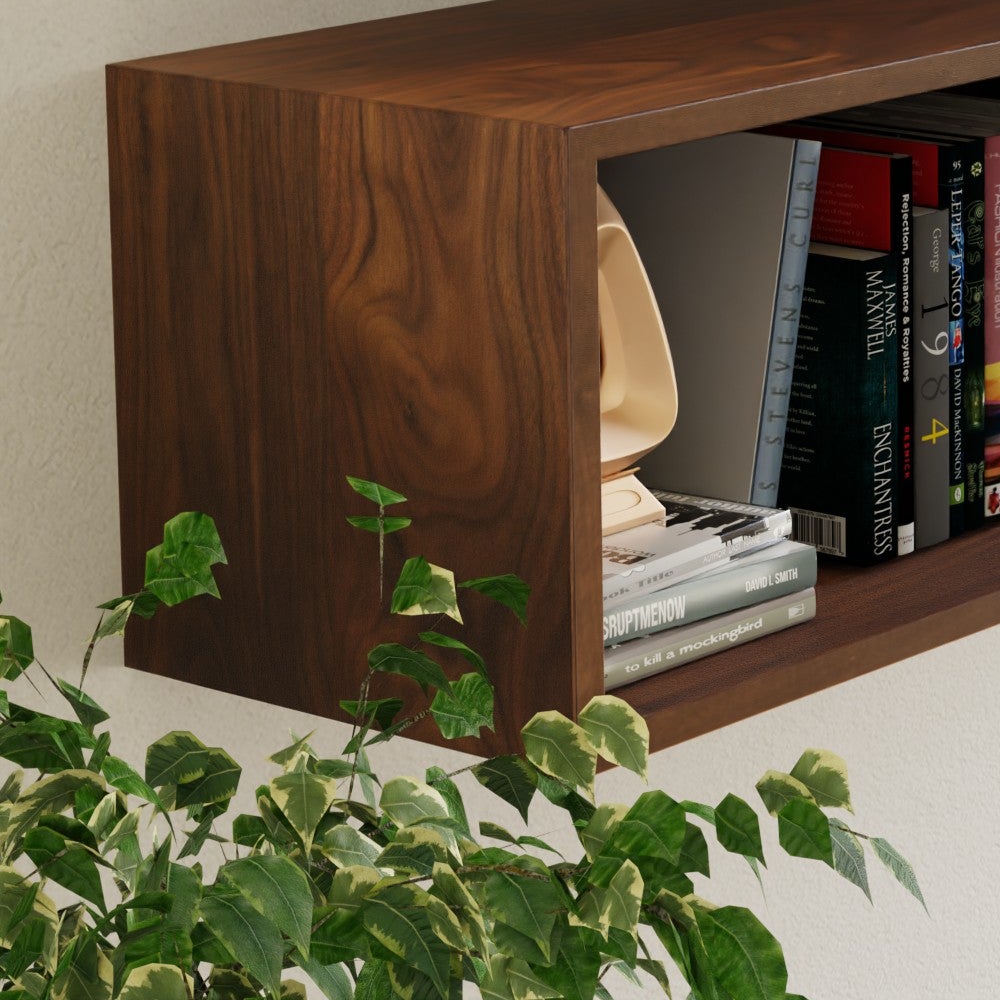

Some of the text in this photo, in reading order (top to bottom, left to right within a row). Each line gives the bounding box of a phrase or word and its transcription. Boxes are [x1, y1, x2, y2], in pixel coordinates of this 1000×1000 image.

[902, 193, 911, 382] Rejection, Romance & Royalties
[930, 228, 941, 273] George
[951, 189, 964, 317] LEPER TANGO
[764, 282, 801, 446] STEVENS
[789, 157, 817, 248] CURL
[865, 269, 885, 360] MAXWELL
[882, 283, 897, 338] JAMES
[953, 368, 963, 480] DAVID MacKINNON
[873, 422, 894, 556] ENCHANTRESS
[638, 569, 674, 588] Title
[703, 550, 727, 564] AUTHOR
[745, 567, 798, 593] DAVID L SMITH
[624, 617, 763, 674] to kill a mockingbird
